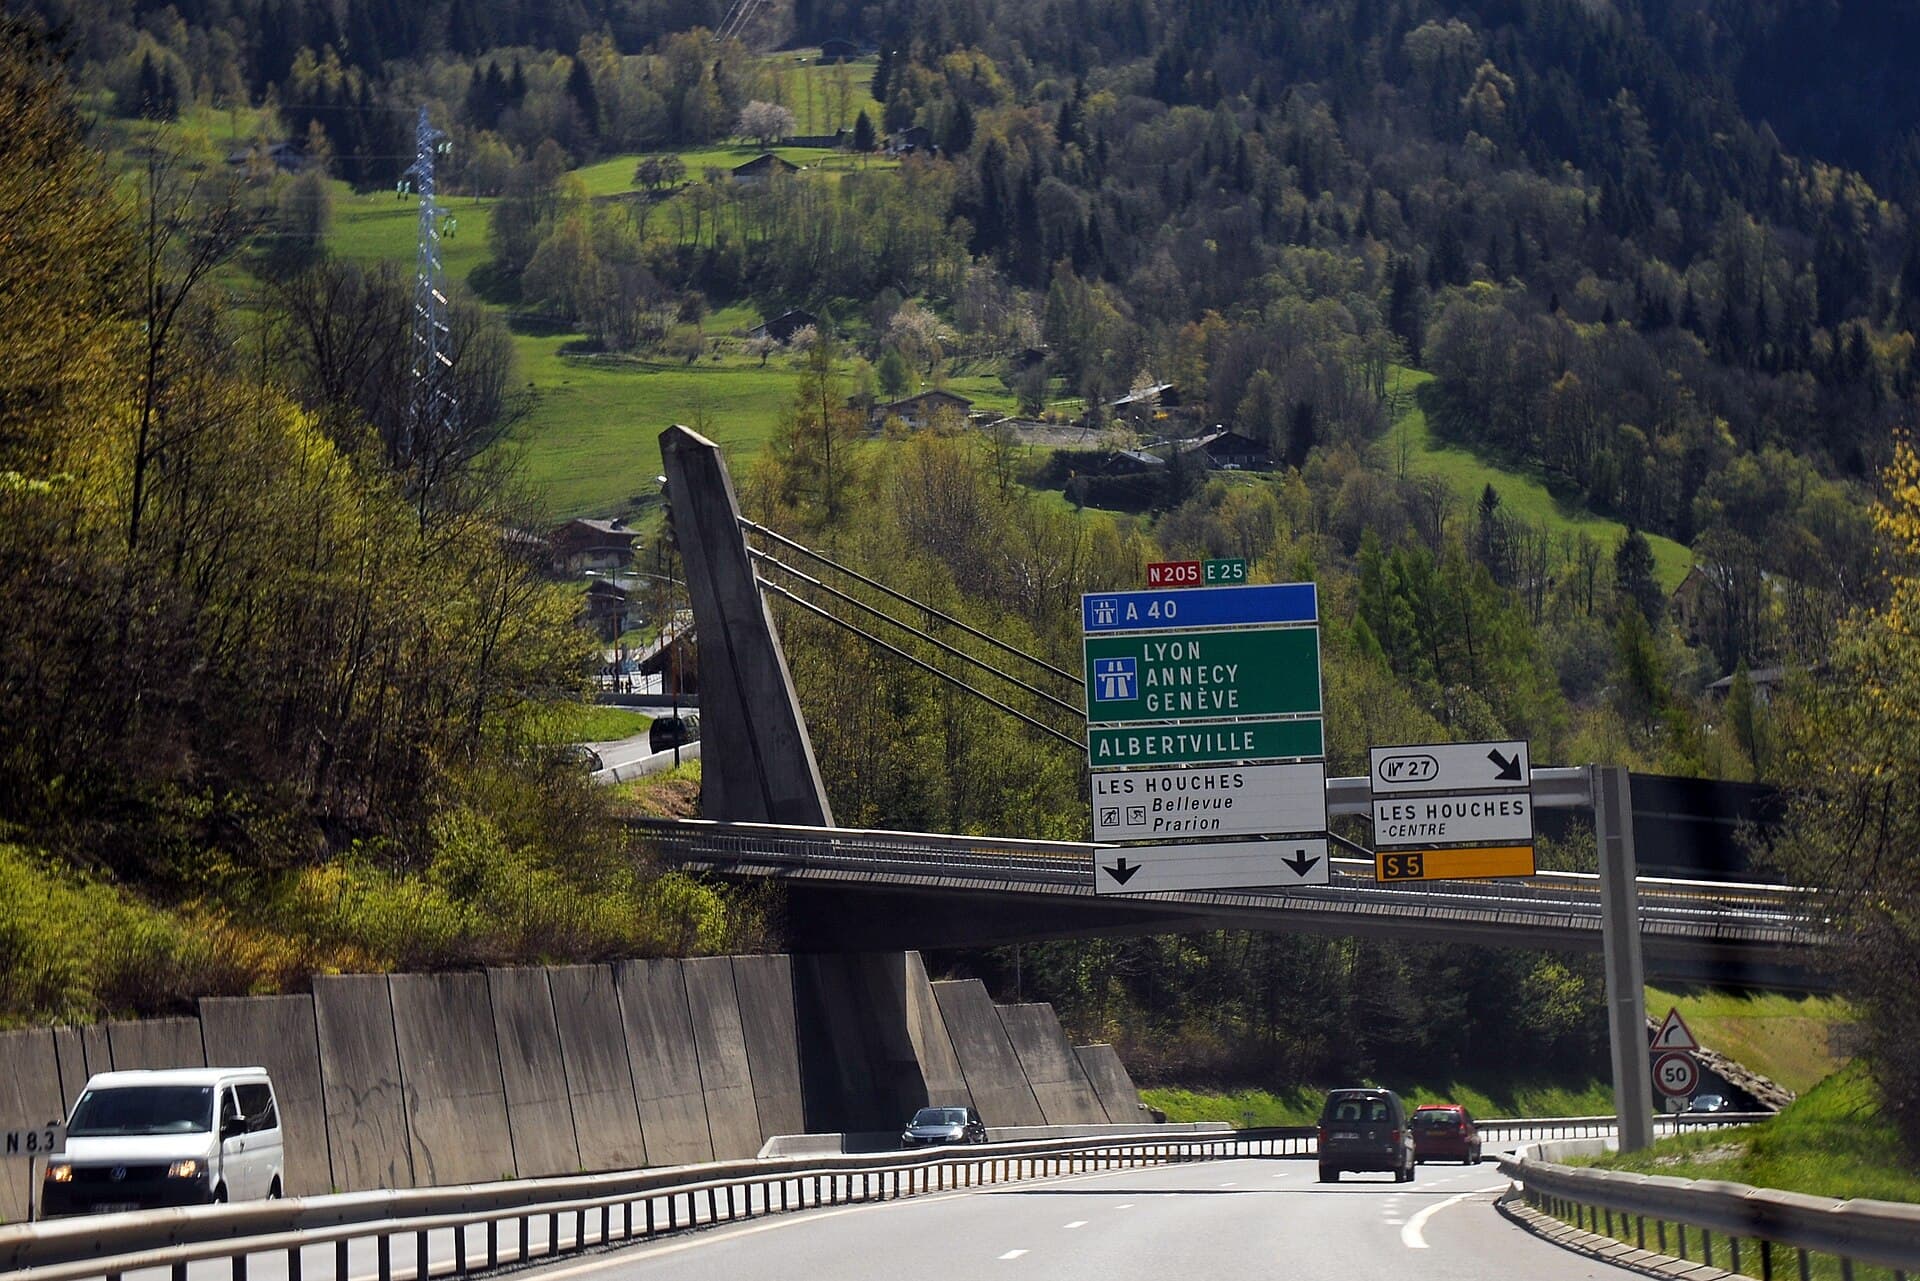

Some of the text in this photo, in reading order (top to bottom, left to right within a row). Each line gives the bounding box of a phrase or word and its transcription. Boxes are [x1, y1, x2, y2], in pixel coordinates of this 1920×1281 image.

[1126, 600, 1177, 620] A 40
[1144, 641, 1200, 662] LYON
[1146, 664, 1238, 687] ANNECY
[1147, 687, 1238, 712] GENÈVE
[1099, 731, 1255, 757] ALBERTVILLE
[1098, 774, 1244, 795] LES HOUCHES
[1152, 797, 1233, 812] Bellevue
[1380, 800, 1524, 821] LES HOUCHES
[1153, 817, 1220, 832] Prarion
[1665, 1067, 1687, 1082] 50
[7, 1133, 18, 1153] N
